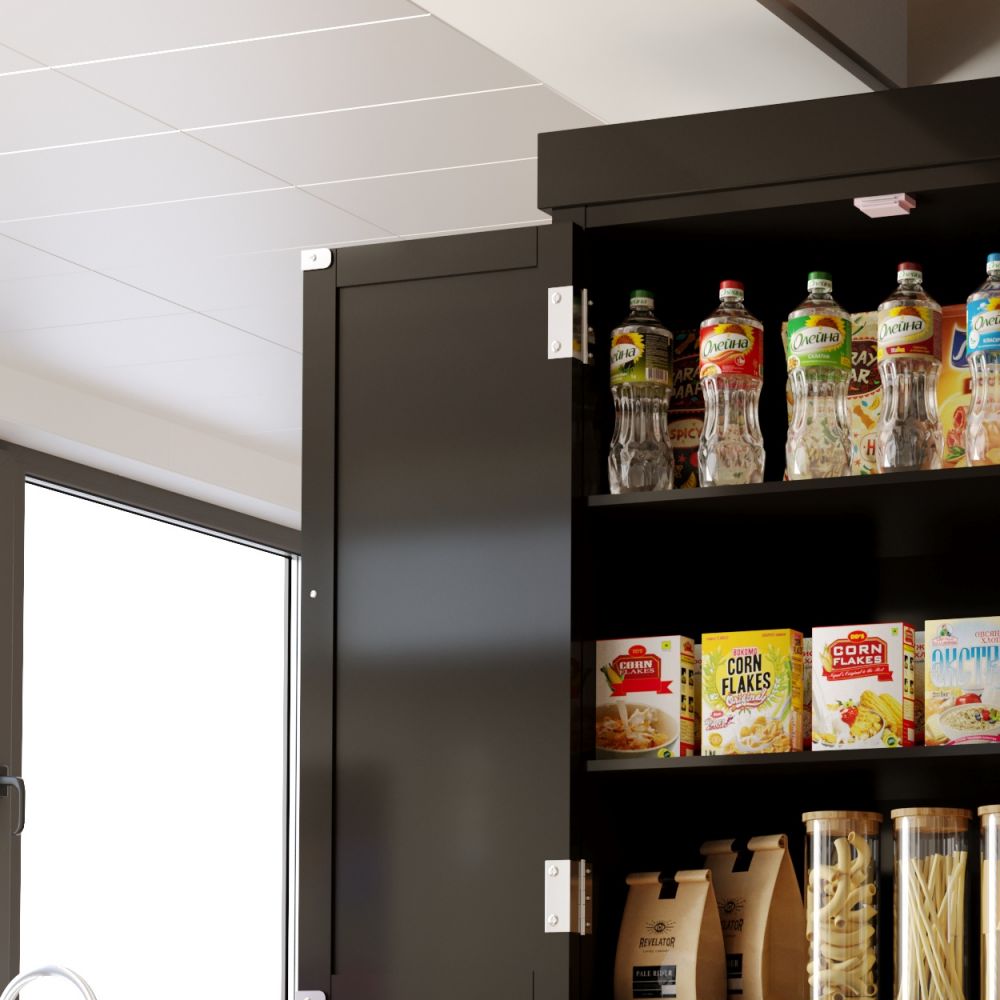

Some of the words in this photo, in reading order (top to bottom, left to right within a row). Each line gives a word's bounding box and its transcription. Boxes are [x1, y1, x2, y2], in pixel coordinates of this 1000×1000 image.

[880, 320, 923, 341] Олейна
[703, 338, 749, 357] Олейна
[793, 331, 840, 350] Олейна
[833, 643, 882, 656] CORN
[619, 660, 653, 670] CORN
[728, 653, 762, 675] CORN
[833, 656, 882, 666] FLAKES
[721, 672, 771, 695] FLAKES
[639, 936, 676, 948] REVELATOR
